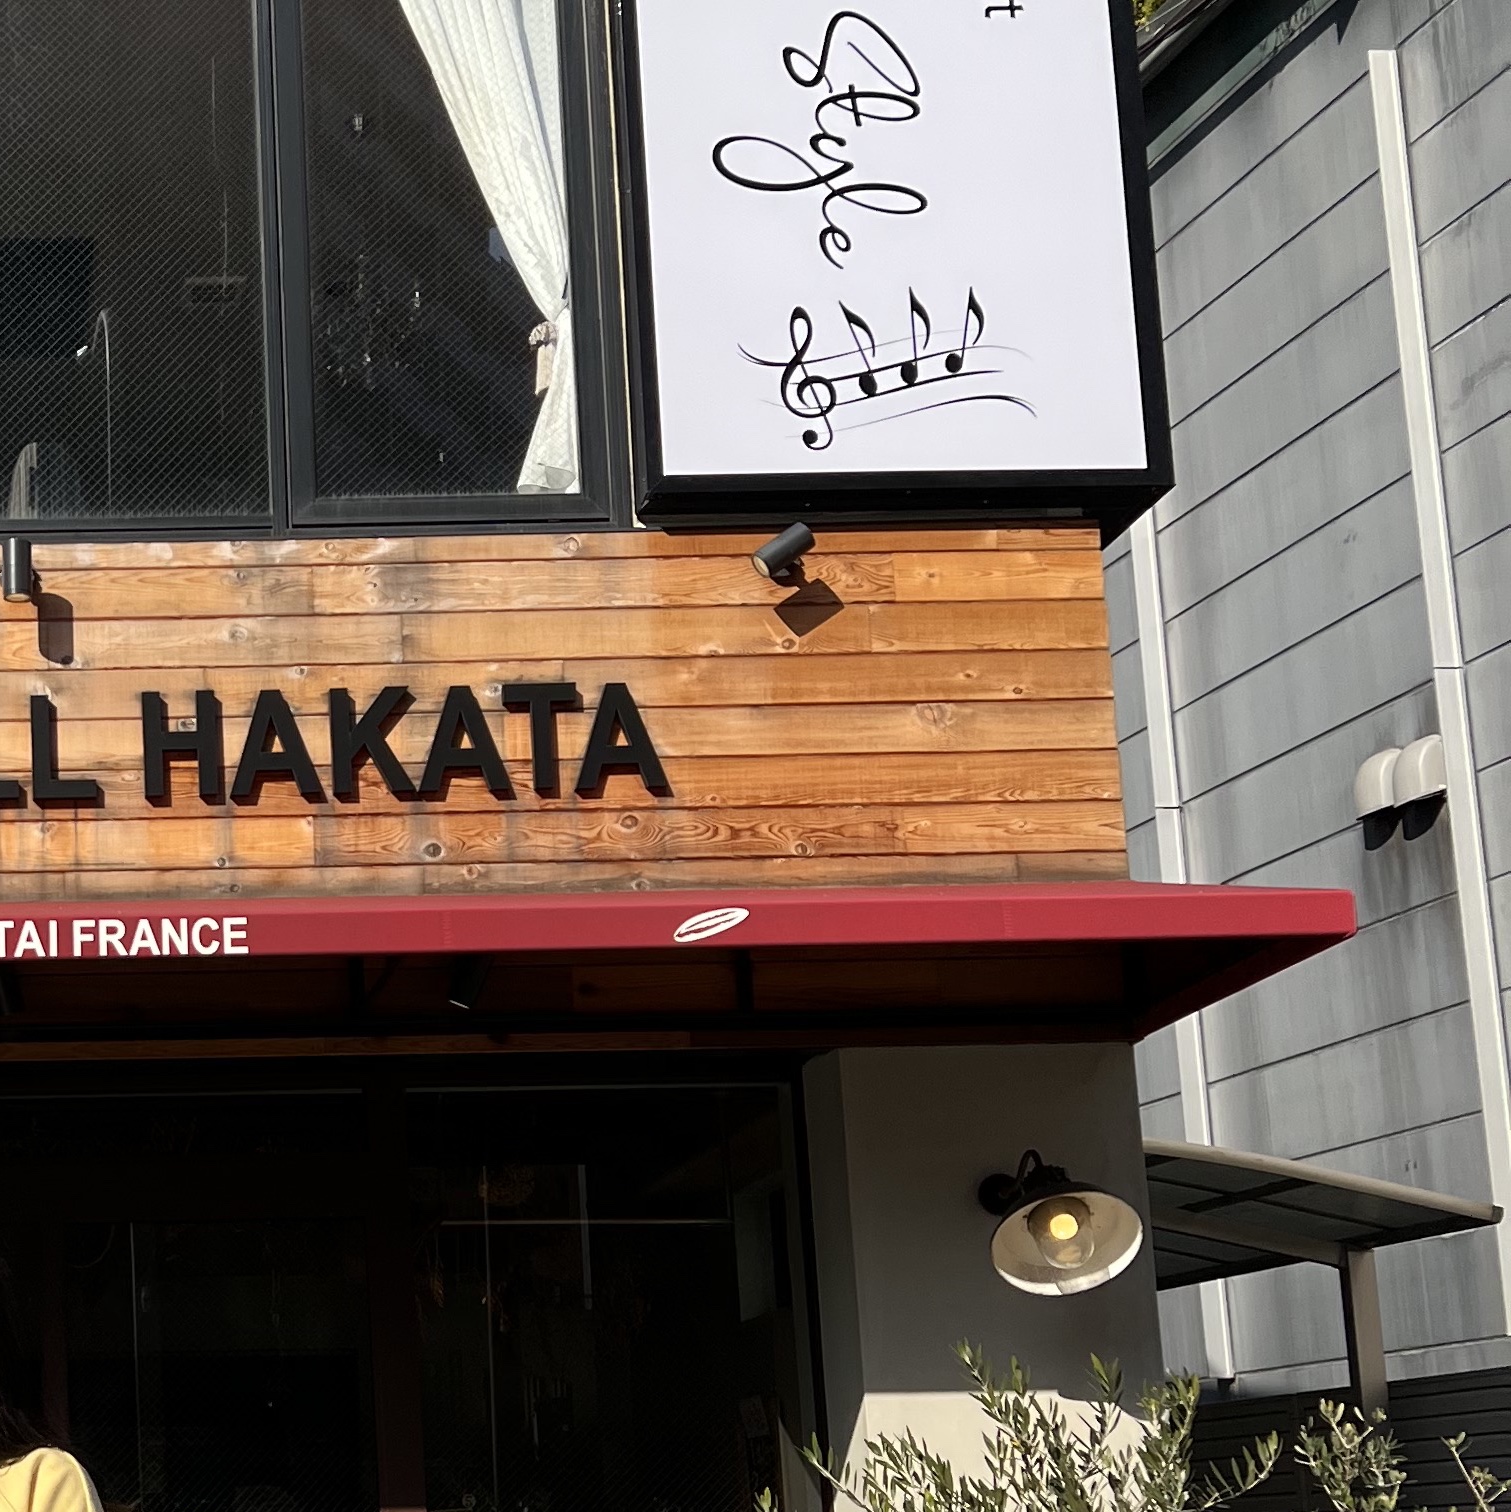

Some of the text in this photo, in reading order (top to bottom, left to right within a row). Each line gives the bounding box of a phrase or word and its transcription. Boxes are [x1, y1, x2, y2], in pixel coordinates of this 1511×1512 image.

[712, 10, 928, 270] Style
[141, 682, 672, 805] HAKATA
[72, 917, 249, 957] FRANCE
